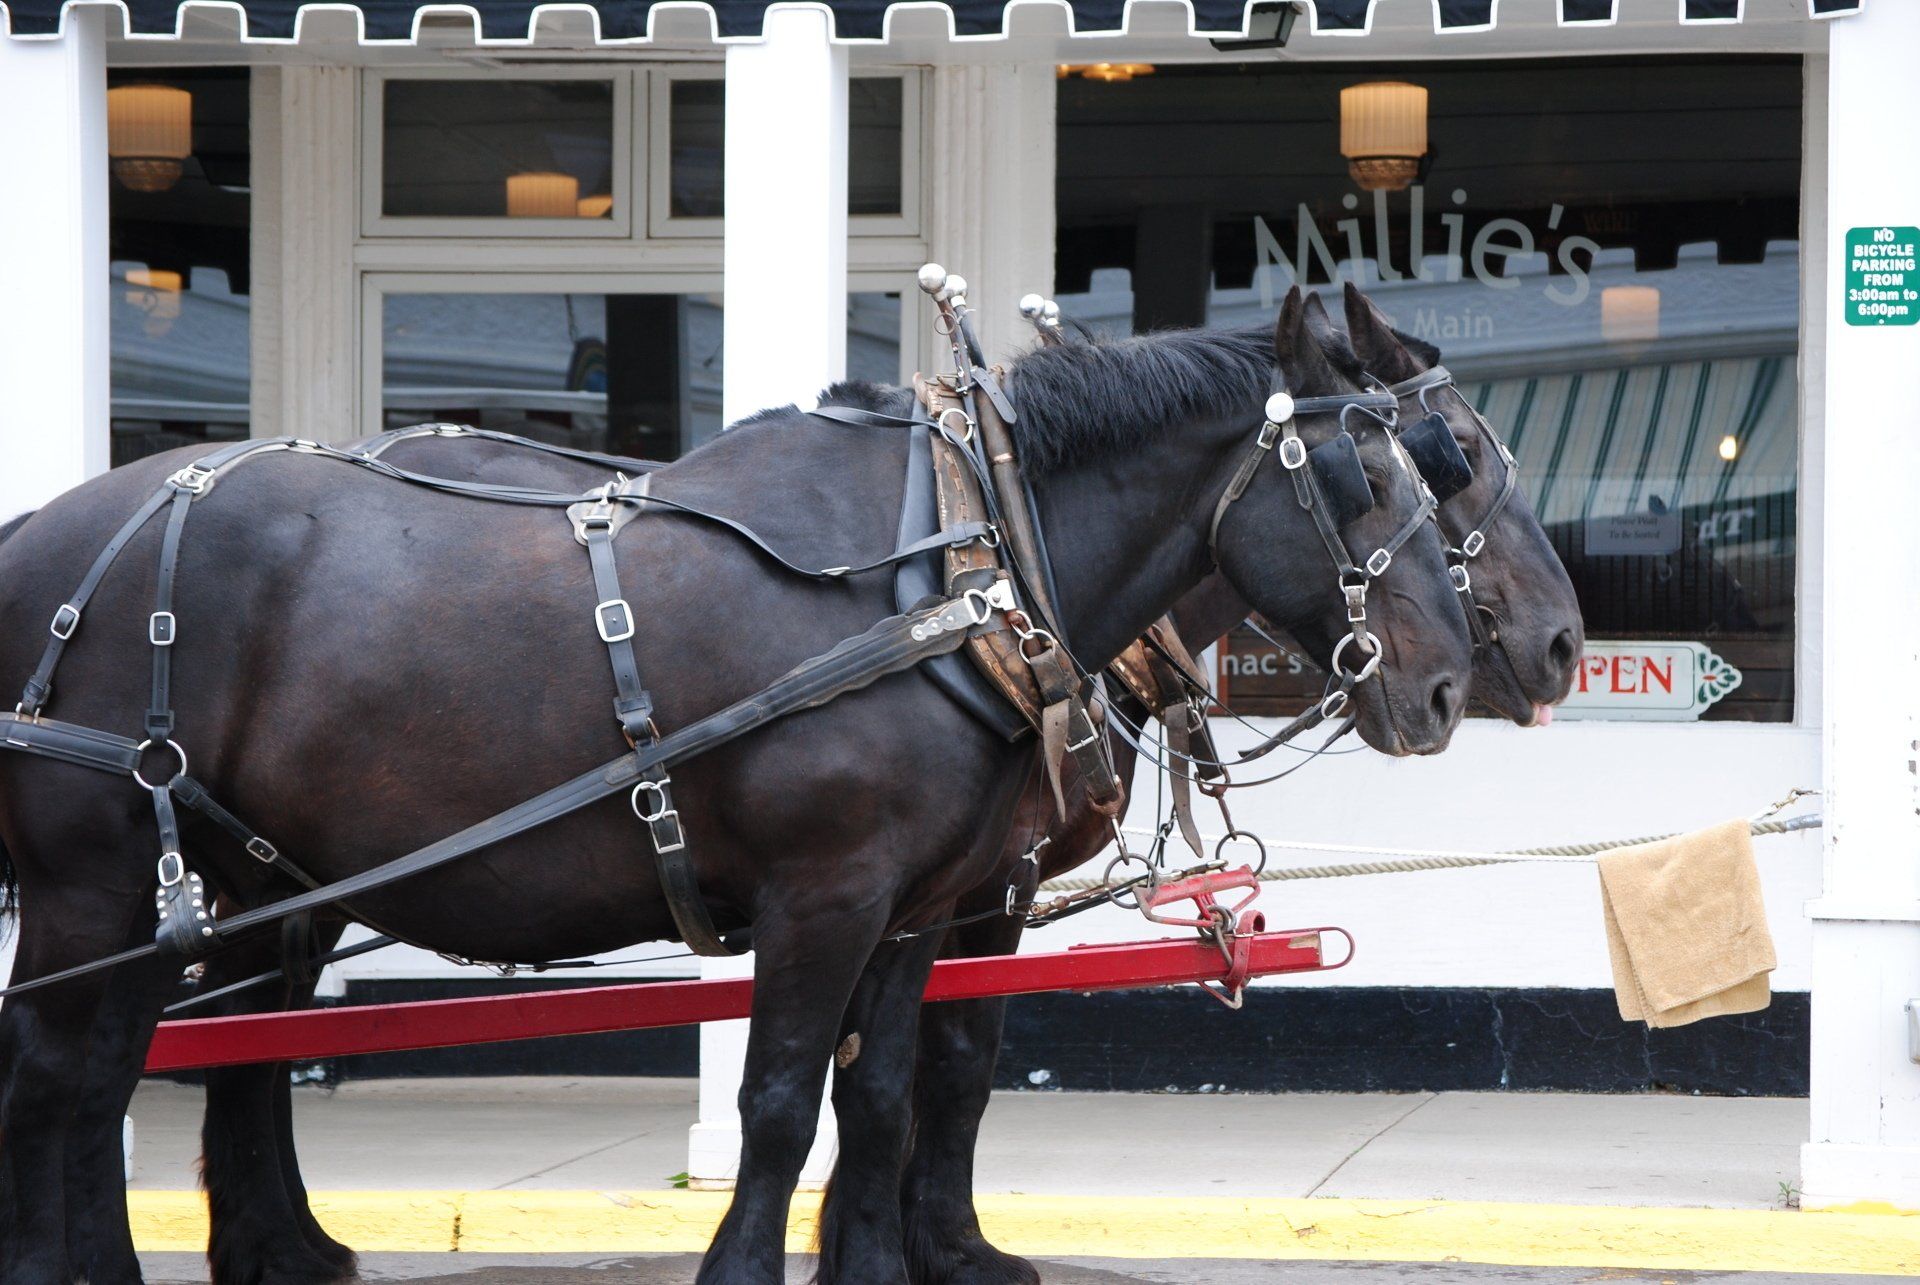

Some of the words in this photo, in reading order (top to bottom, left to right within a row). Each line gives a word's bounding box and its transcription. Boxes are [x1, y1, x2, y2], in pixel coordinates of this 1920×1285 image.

[1873, 229, 1895, 242] NO
[1254, 185, 1603, 309] Millie's
[1854, 244, 1914, 257] BICYCLE
[1852, 259, 1916, 272] PARKING
[1863, 273, 1904, 286] FROM
[1849, 288, 1899, 301] 3:00am
[1903, 288, 1918, 301] to
[1857, 303, 1909, 318] 6:00pm
[1412, 308, 1493, 338] Main
[1577, 655, 1672, 694] PEN
